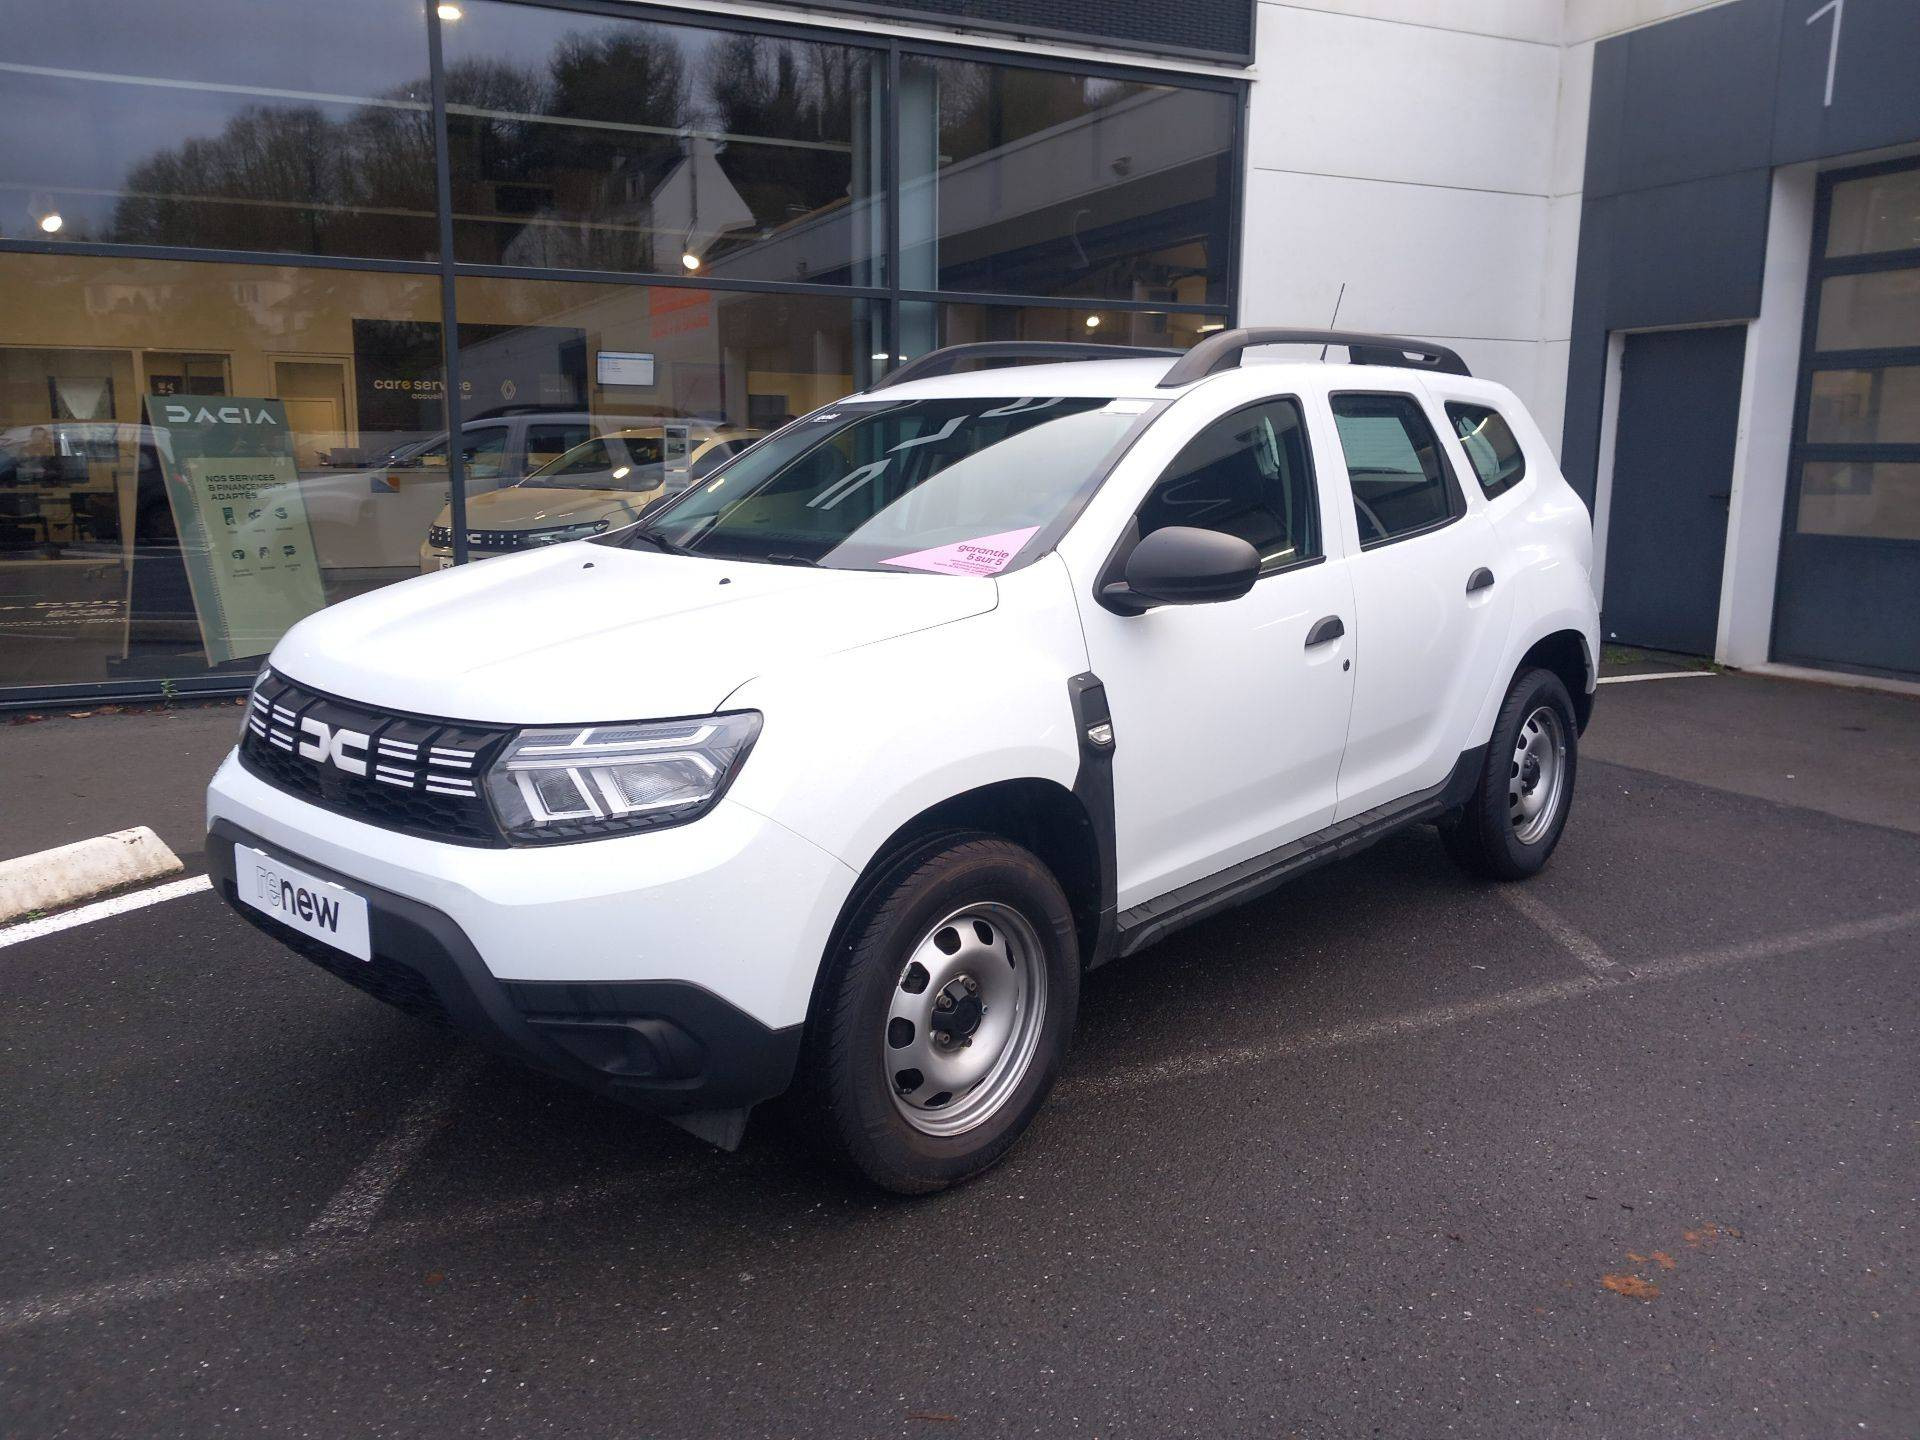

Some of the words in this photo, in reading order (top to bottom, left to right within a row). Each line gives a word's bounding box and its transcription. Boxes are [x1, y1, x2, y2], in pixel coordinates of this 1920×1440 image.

[1806, 0, 1844, 107] 1
[374, 379, 412, 390] care
[414, 380, 472, 391] serve
[165, 406, 277, 424] DACIA
[229, 474, 275, 482] SERVICES
[957, 544, 1009, 558] garantie
[966, 553, 975, 561] 5
[974, 556, 995, 564] sur
[995, 558, 1004, 566] 5
[256, 865, 340, 933] renew
